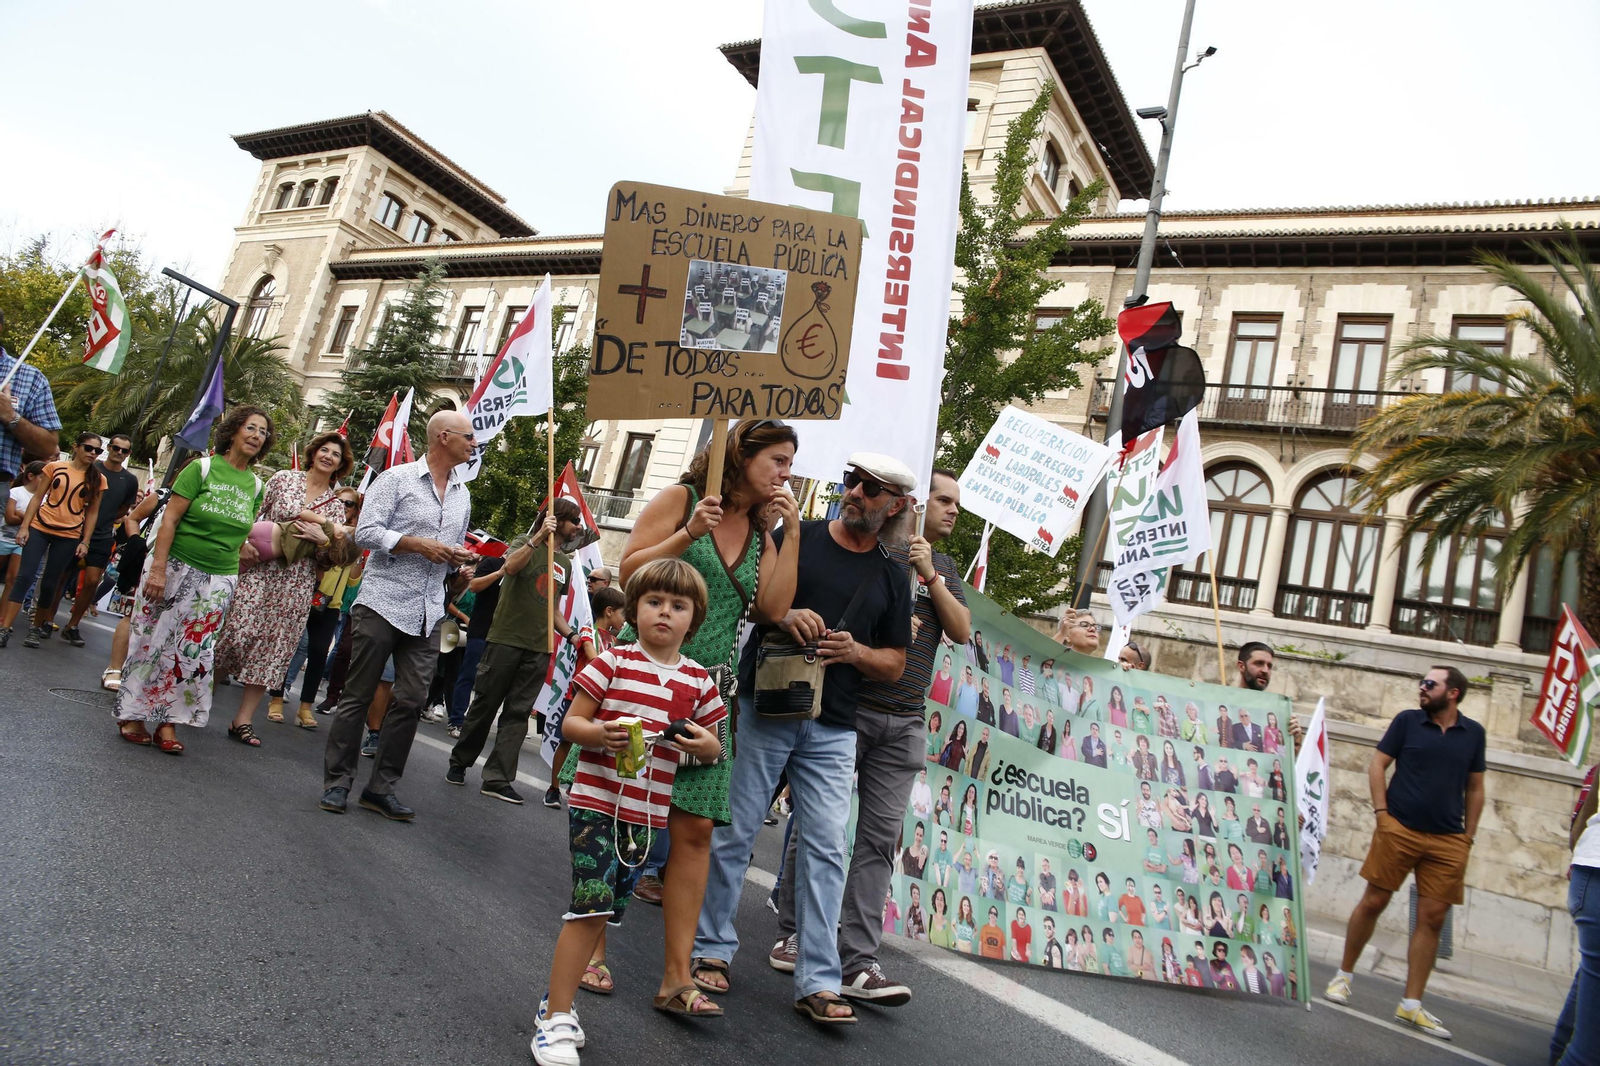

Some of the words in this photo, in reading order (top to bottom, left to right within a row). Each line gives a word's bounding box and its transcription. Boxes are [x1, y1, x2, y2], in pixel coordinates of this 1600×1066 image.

[611, 189, 667, 224] MAS
[772, 219, 816, 245] PARA
[827, 228, 848, 250] LA
[651, 228, 750, 265] ESCUELA
[994, 433, 1007, 448] DE
[1009, 441, 1029, 457] LOS
[1030, 450, 1085, 483] DERECHOS
[1005, 458, 1062, 493] LABORALES
[965, 478, 1004, 504] EMPLEO
[1033, 492, 1054, 509] DEL
[990, 760, 1091, 806] ¿escuela
[986, 788, 1086, 832] pública?
[1097, 799, 1132, 842] SÍ
[1027, 835, 1048, 845] MAREA
[1048, 840, 1067, 851] VERDE
